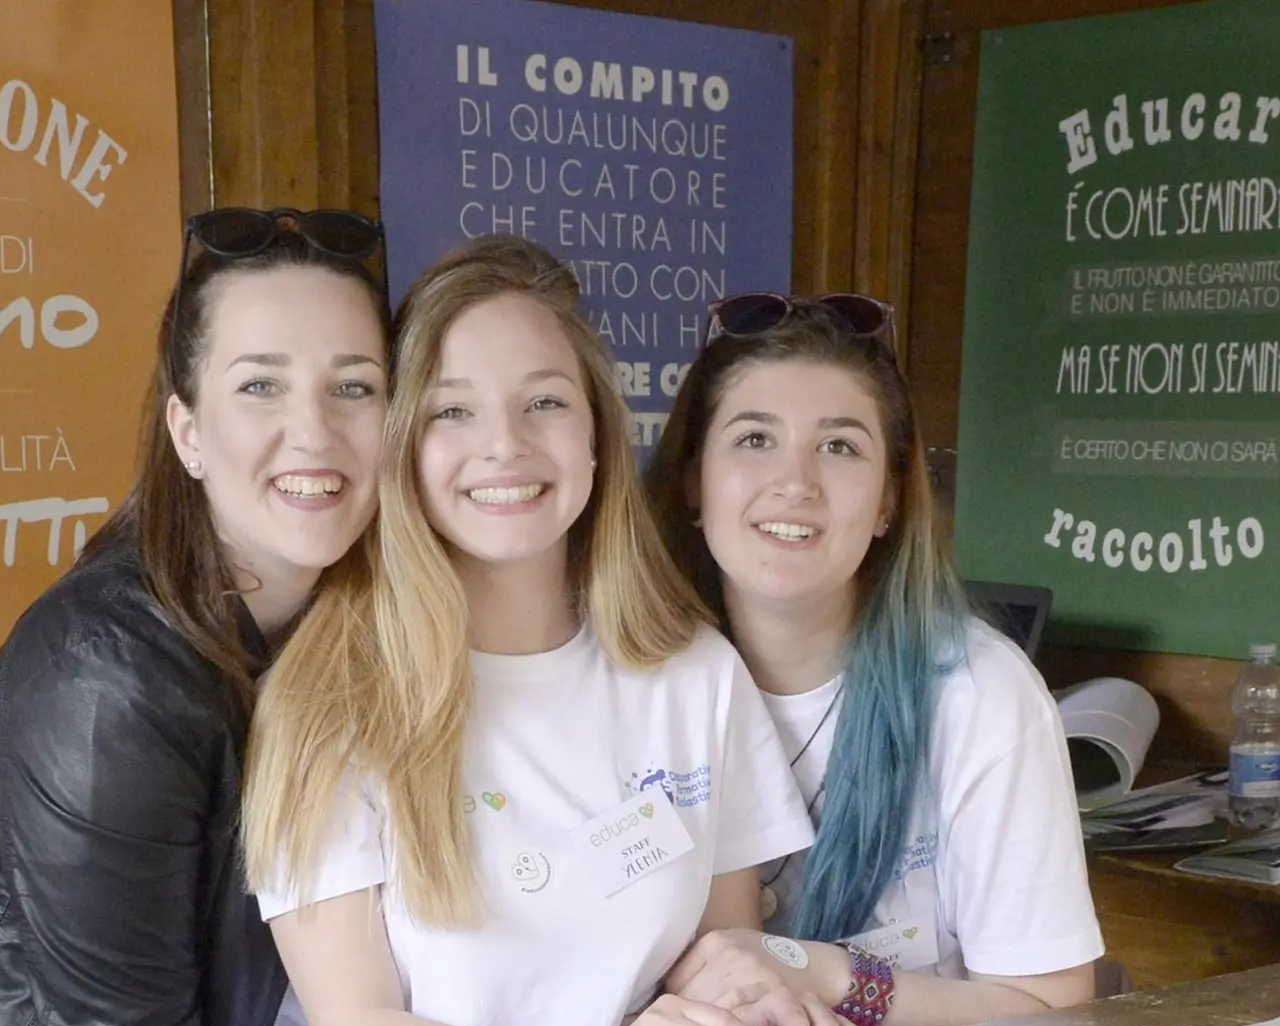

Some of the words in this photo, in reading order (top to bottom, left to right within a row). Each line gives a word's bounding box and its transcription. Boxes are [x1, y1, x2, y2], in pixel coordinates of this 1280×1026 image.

[456, 44, 498, 86] IL
[524, 53, 730, 112] COMPITO
[459, 97, 492, 137] DI
[509, 103, 727, 161] QUALUNQUE
[462, 149, 726, 209] EDUCATORE
[459, 201, 537, 243] CHE
[558, 209, 672, 252] ENTRA
[691, 219, 726, 256] IN
[1085, 184, 1170, 240] COME
[0, 235, 35, 275] DI
[569, 260, 639, 298] ATTO
[650, 264, 726, 301] CON
[1090, 289, 1134, 314] NON
[589, 309, 659, 346] ANI
[1056, 346, 1090, 394] MA
[1095, 344, 1120, 395] SE
[1126, 342, 1184, 394] NON
[1191, 342, 1208, 394] SI
[1130, 440, 1169, 461] CHE
[1168, 439, 1209, 461] NON
[1044, 507, 1265, 573] raccolto
[588, 811, 640, 848] educa
[620, 836, 651, 860] STAFF
